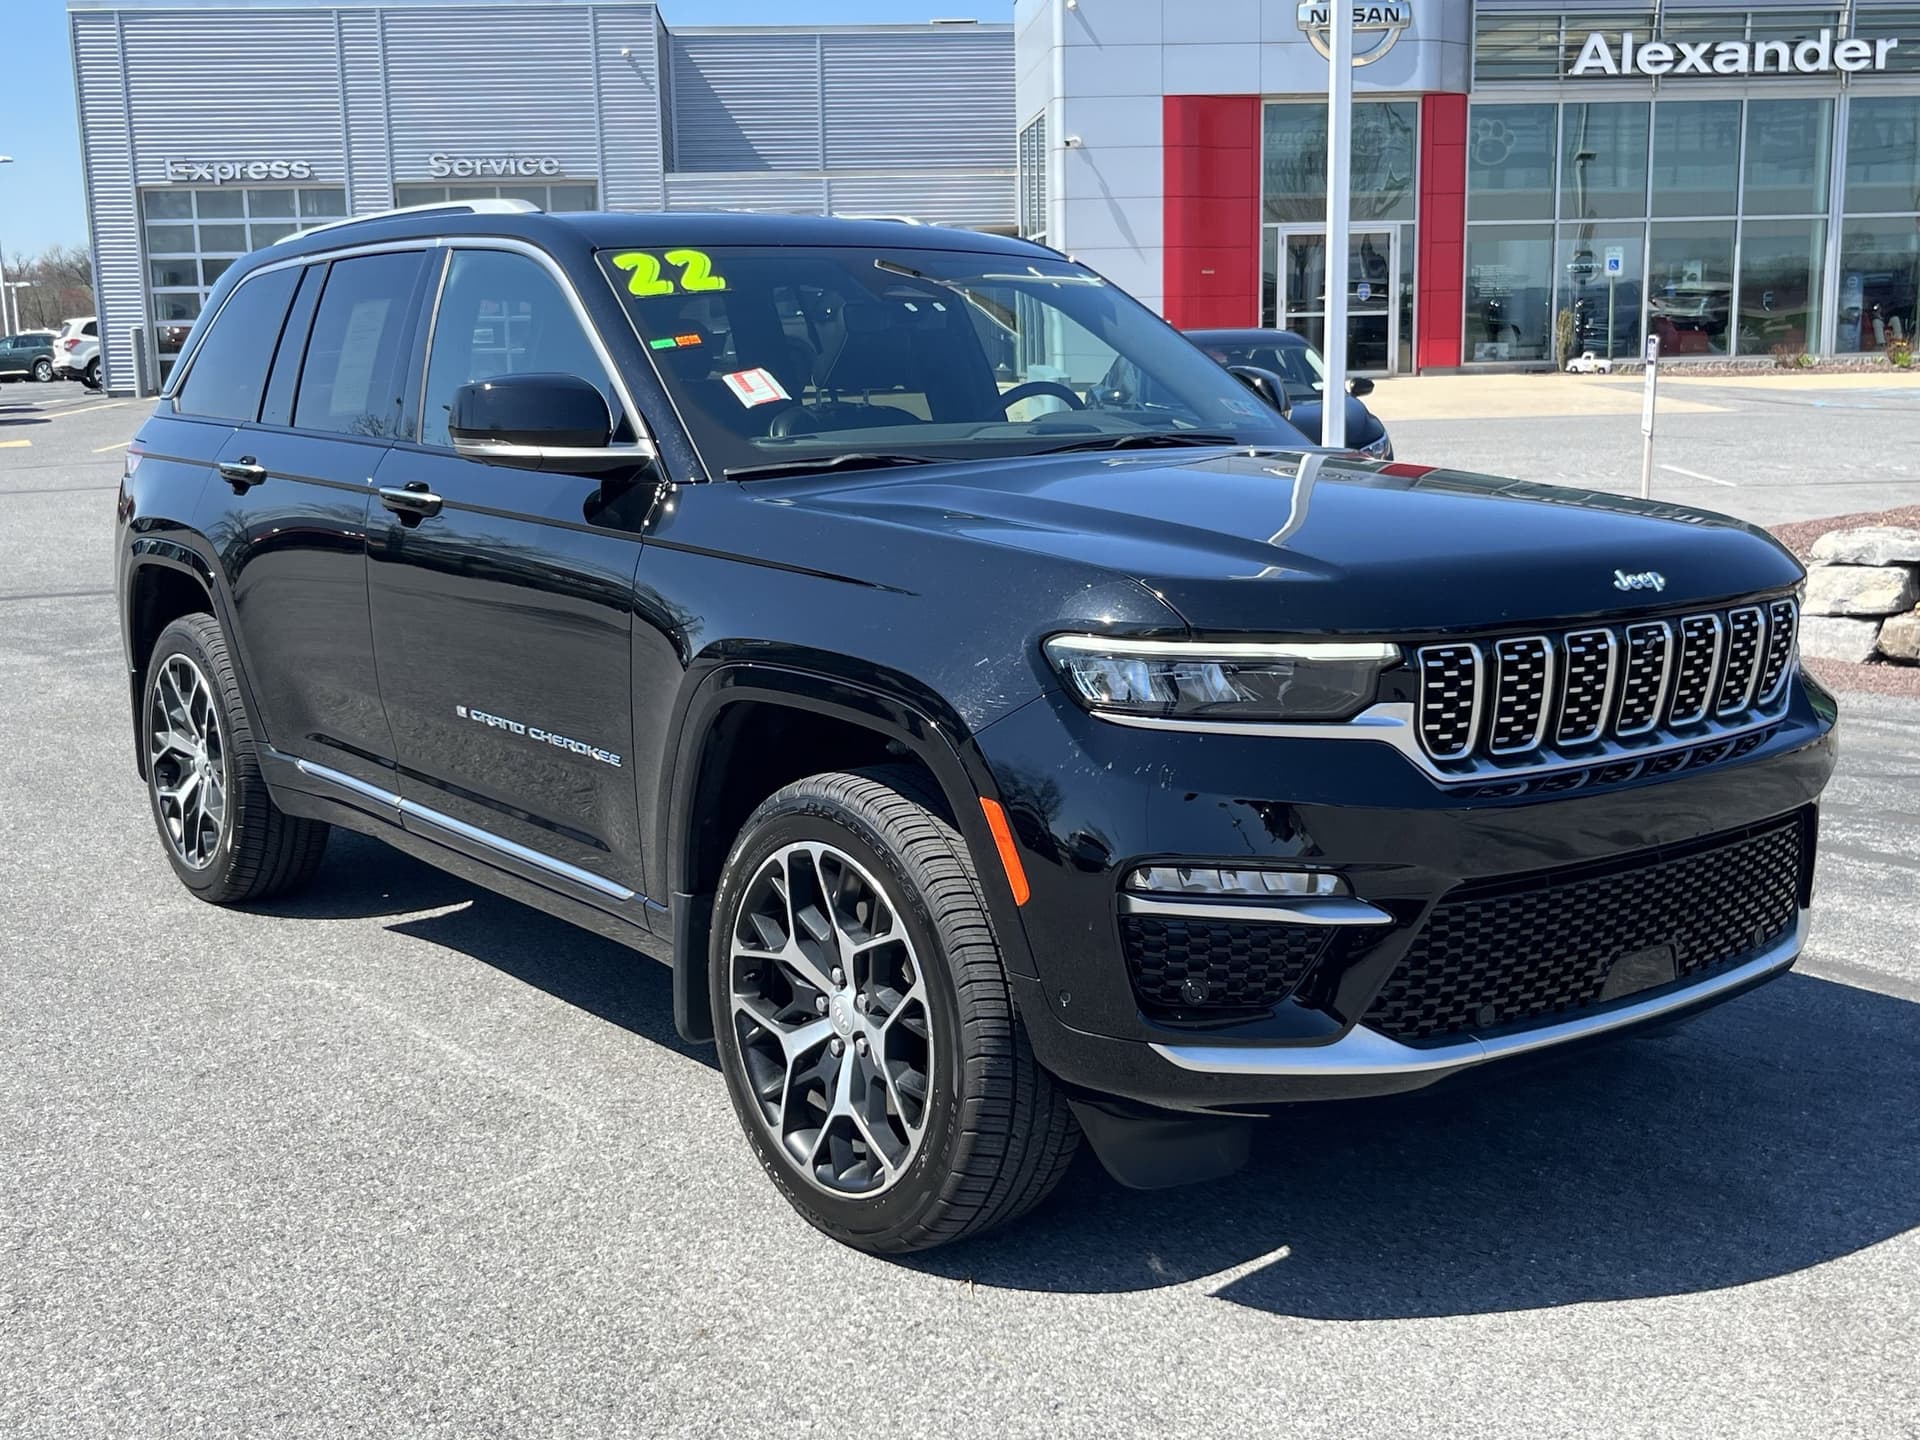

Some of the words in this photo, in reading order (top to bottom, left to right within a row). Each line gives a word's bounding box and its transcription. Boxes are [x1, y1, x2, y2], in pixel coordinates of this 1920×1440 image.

[1310, 7, 1400, 23] NSAN
[1570, 29, 1898, 75] Alexander
[164, 156, 311, 185] Express
[428, 152, 561, 177] Service
[612, 249, 727, 297] 22
[1613, 569, 1665, 592] Jeep
[470, 709, 526, 736] GRAND
[528, 727, 623, 768] CHEROKEE
